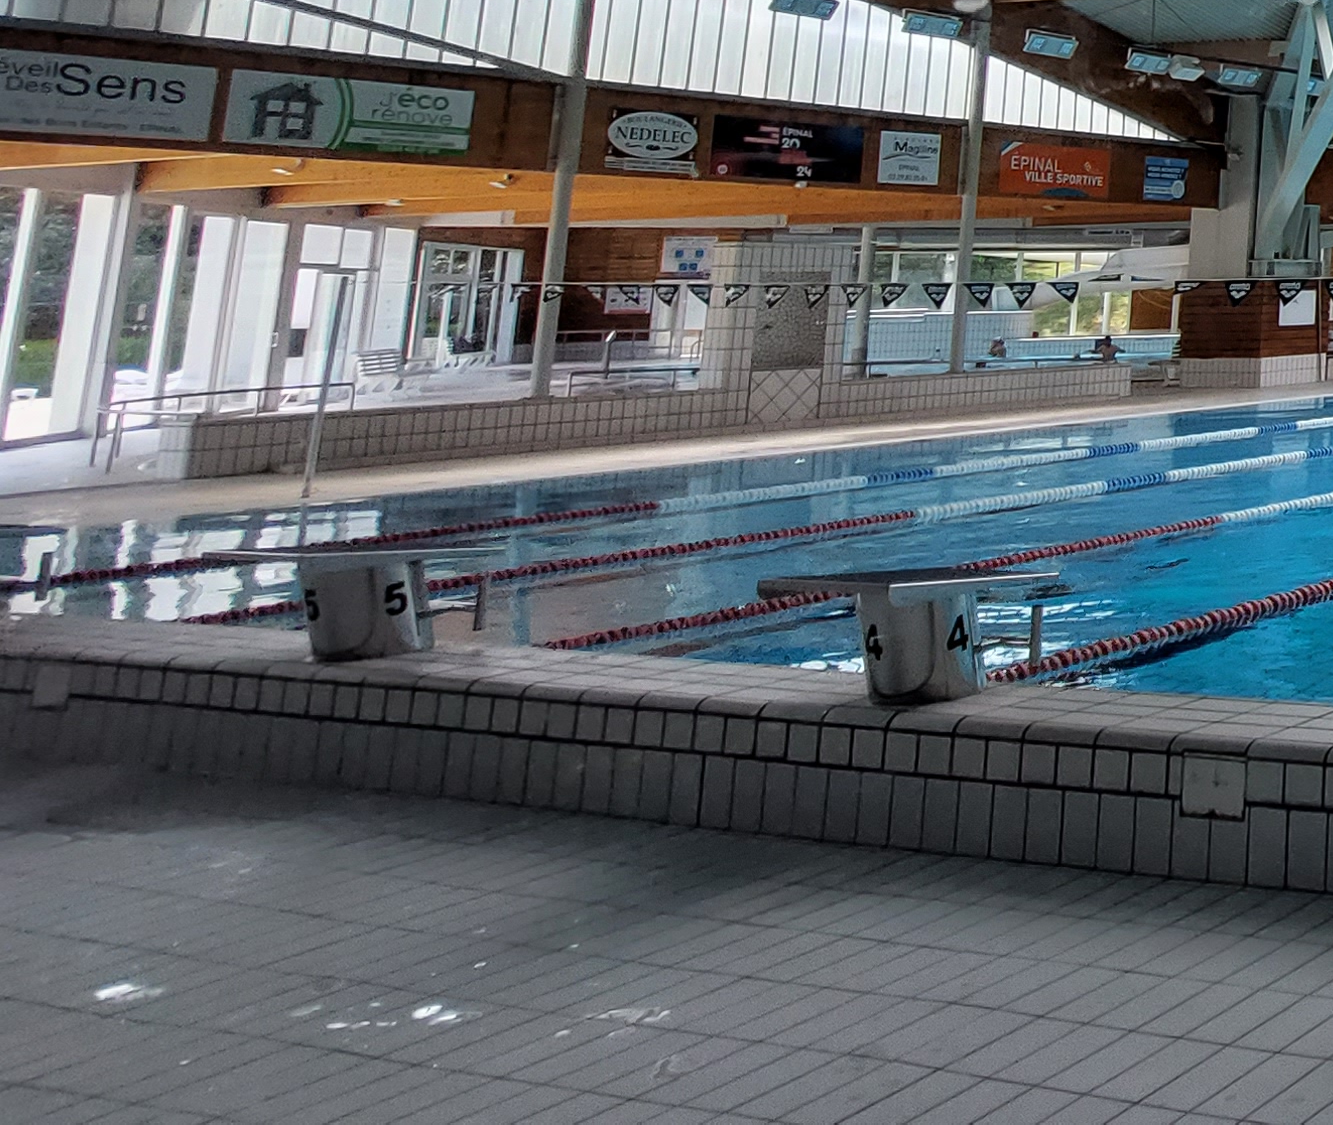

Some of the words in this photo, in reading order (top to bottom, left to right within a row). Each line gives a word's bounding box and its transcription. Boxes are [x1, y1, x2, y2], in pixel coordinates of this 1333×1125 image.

[6, 75, 53, 93] Des
[56, 62, 187, 104] Sens
[615, 125, 692, 144] NEDELEC
[781, 137, 801, 149] 20
[796, 165, 812, 177] 24
[1010, 151, 1062, 173] ÉPINAL
[1024, 171, 1053, 183] VILLE
[1056, 173, 1104, 187] SPORTIVE
[304, 588, 320, 622] 5
[384, 580, 408, 617] 5
[865, 623, 883, 661] 4
[946, 614, 969, 652] 4
